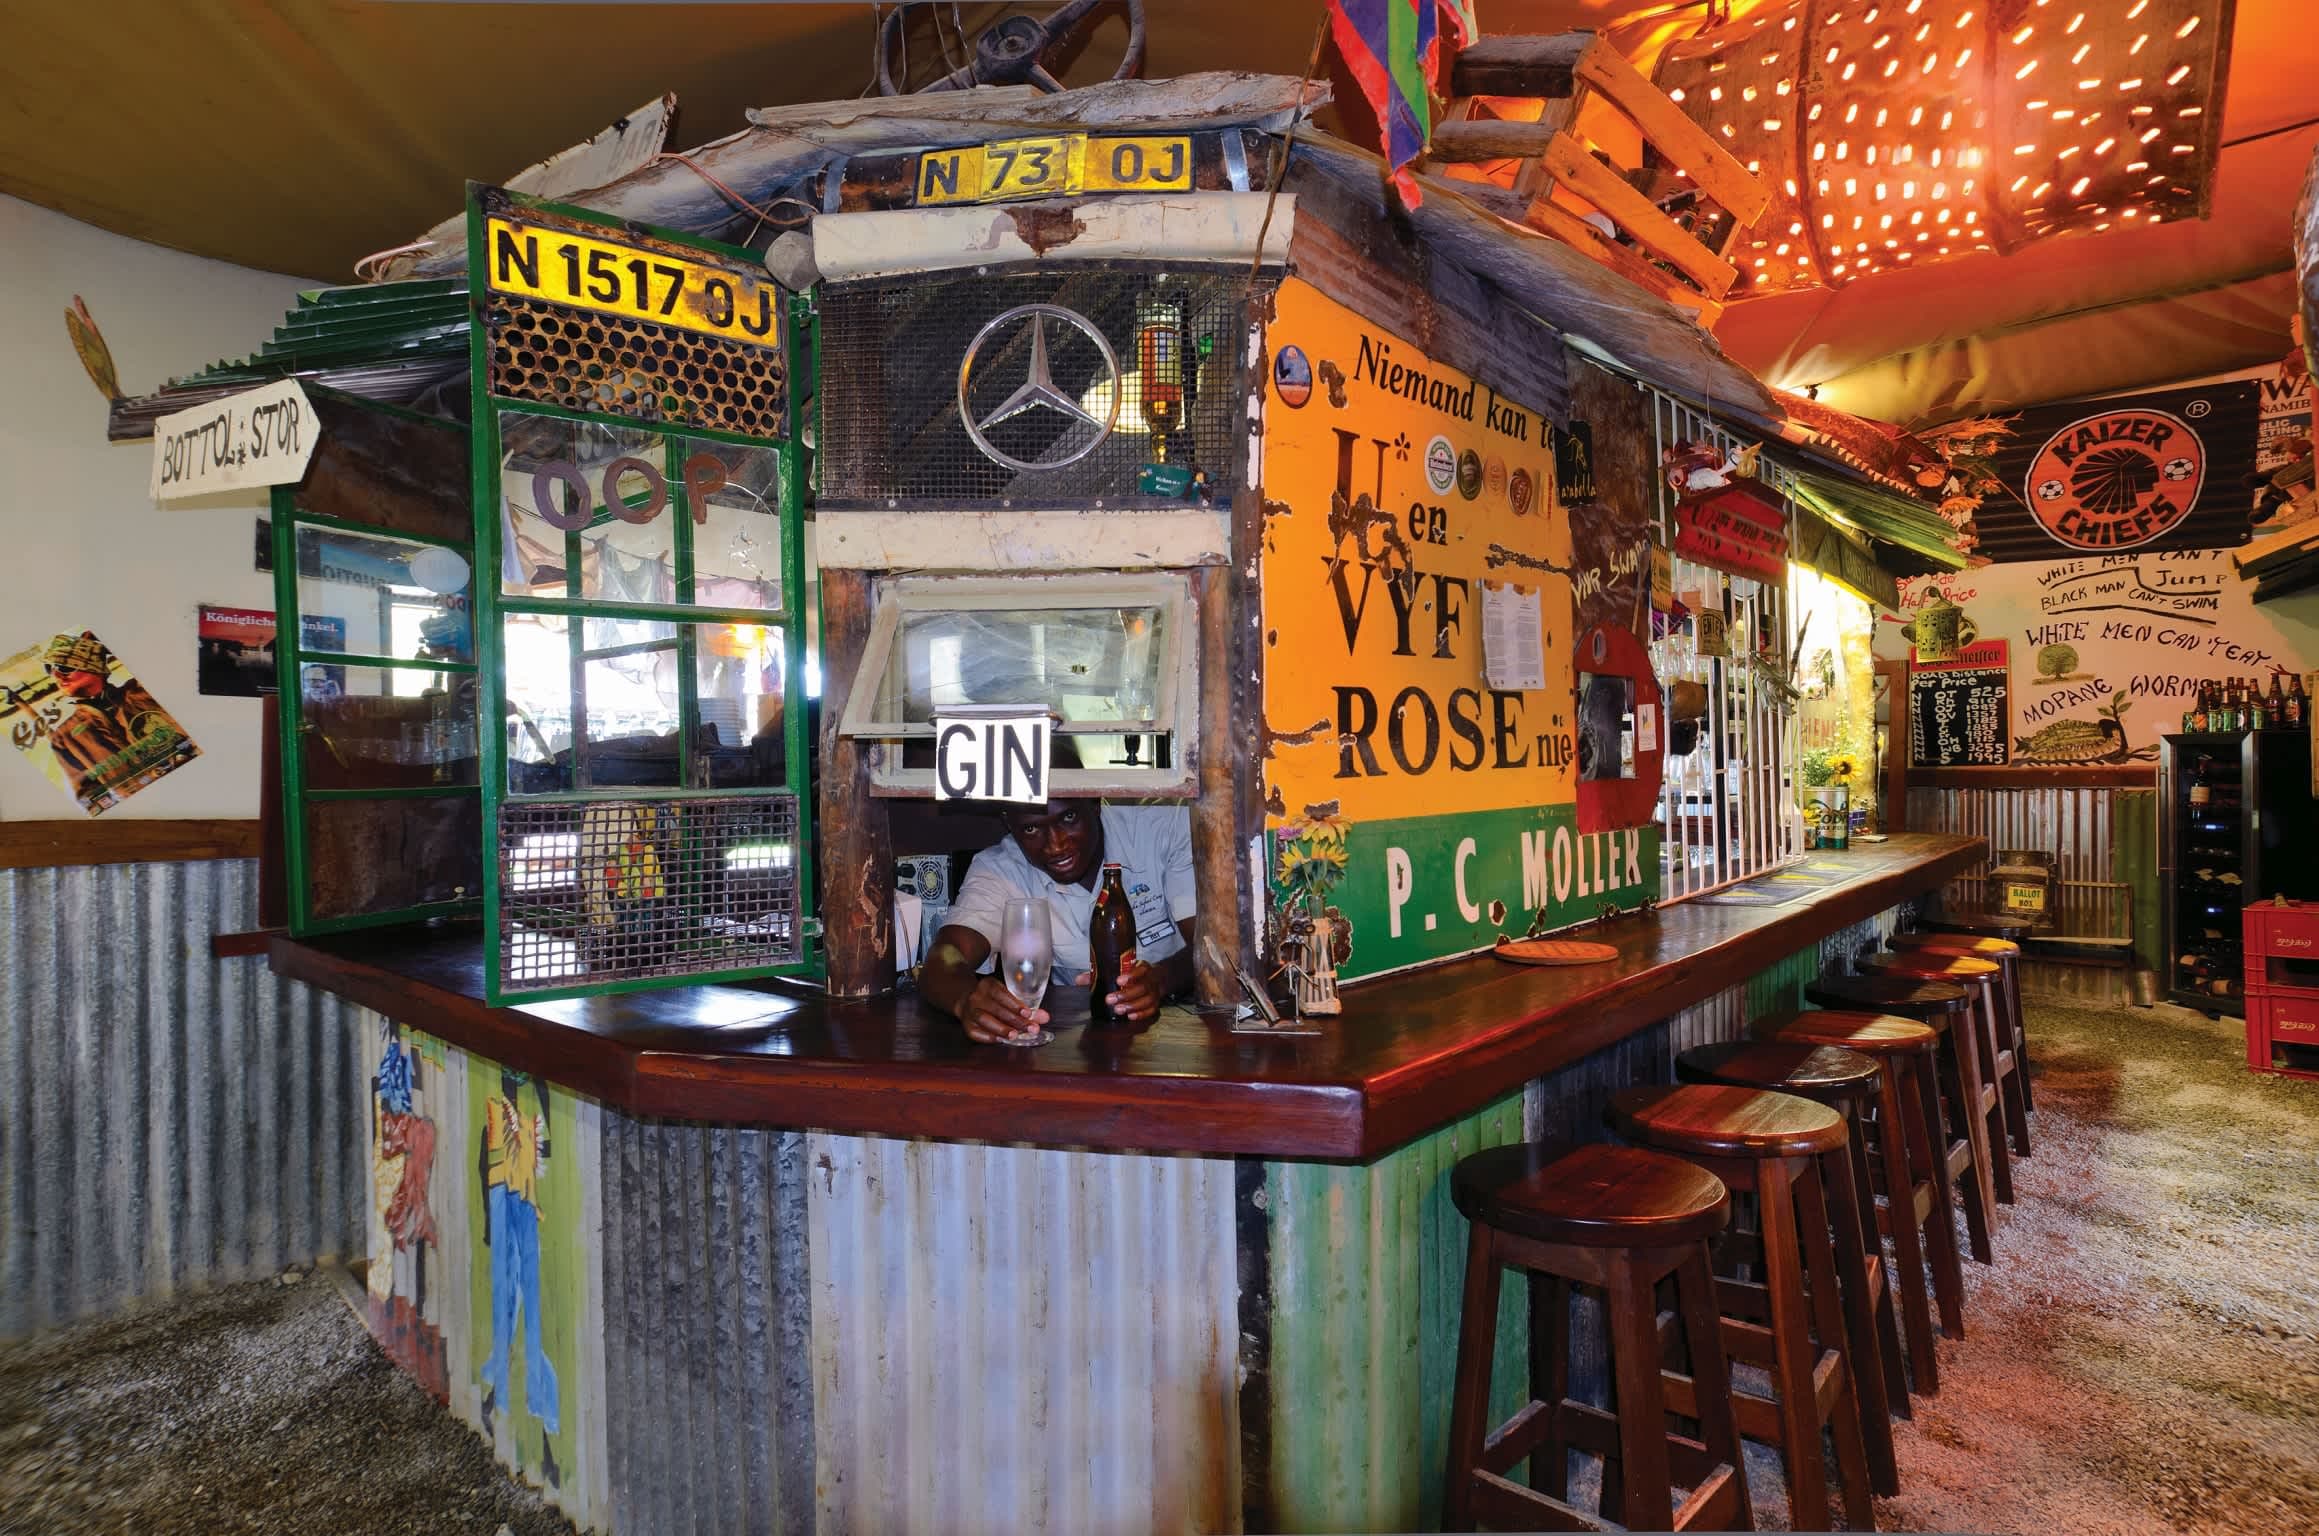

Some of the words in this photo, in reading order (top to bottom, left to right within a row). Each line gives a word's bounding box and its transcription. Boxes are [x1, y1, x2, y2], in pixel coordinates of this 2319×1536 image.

[924, 155, 960, 198] N
[987, 146, 1051, 191] 73
[497, 229, 539, 289] N
[557, 243, 685, 317] 1517
[1353, 333, 1474, 422] Niemand
[1485, 386, 1528, 442] kan
[251, 397, 301, 459] STOR
[2051, 418, 2174, 468] KAIZER
[532, 453, 728, 531] OOP
[1408, 502, 1448, 546] en
[2055, 494, 2179, 545] CHIEFS
[1943, 587, 1977, 602] Price
[2037, 561, 2085, 585] WHITE
[2041, 586, 2088, 611] BLACK
[2095, 580, 2126, 594] MAN
[2172, 597, 2219, 610] SWIM
[1321, 555, 1469, 660] VYF
[2100, 621, 2152, 641] MEN
[1911, 680, 1937, 691] Per
[1941, 677, 1977, 689] Price
[1912, 671, 1948, 679] ROAD
[1951, 668, 2008, 679] Distance
[1970, 686, 2007, 698] 525
[2023, 678, 2113, 724] MOPANE
[1331, 686, 1530, 779] ROSE
[937, 723, 1043, 798] GIN
[1968, 752, 2004, 764] 1995
[2013, 888, 2041, 898] BALLOT
